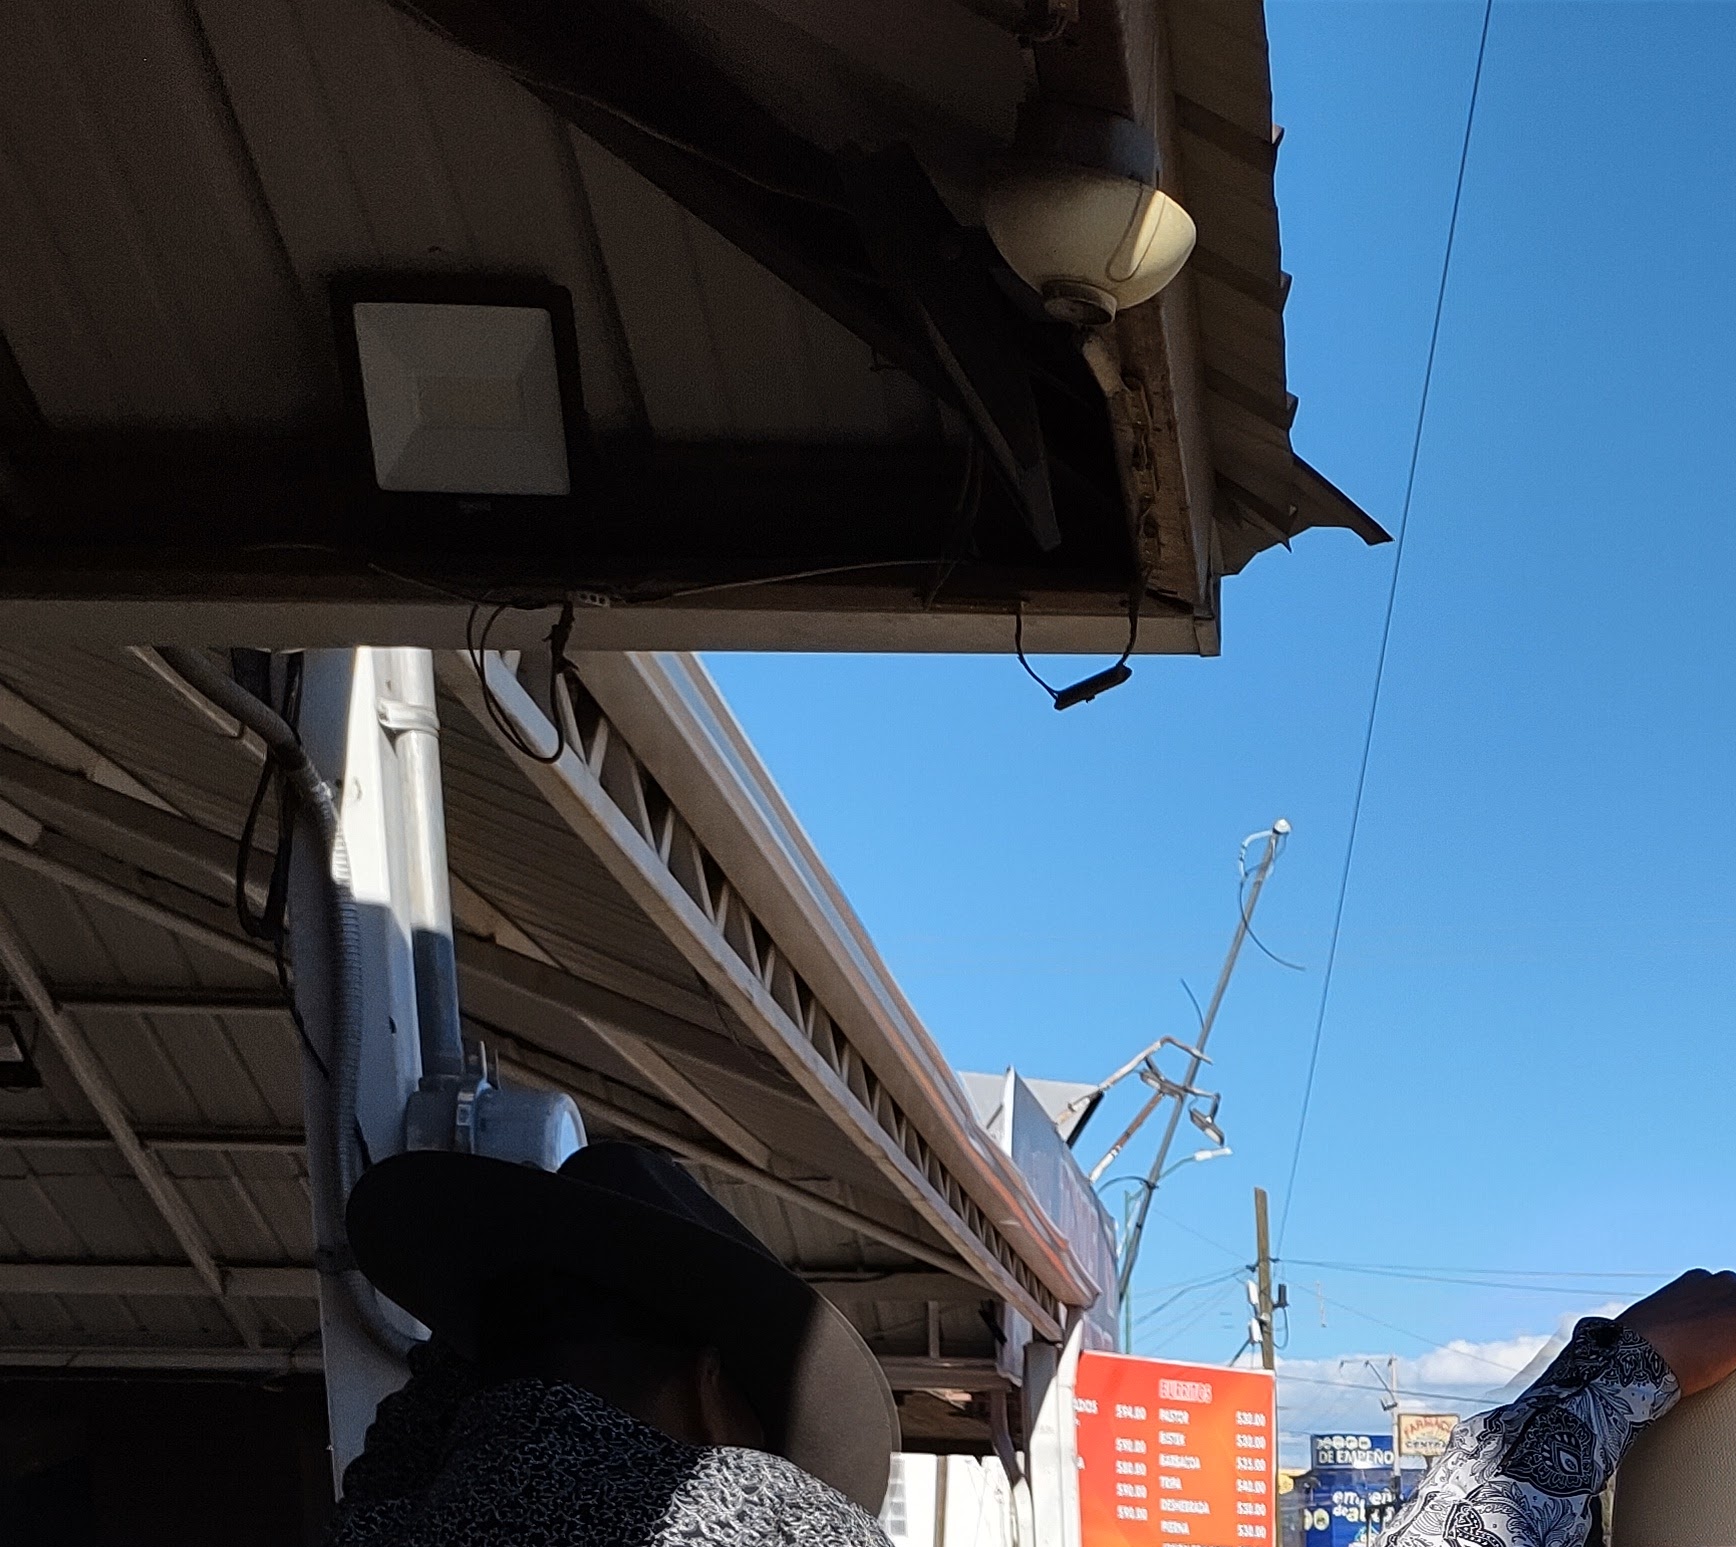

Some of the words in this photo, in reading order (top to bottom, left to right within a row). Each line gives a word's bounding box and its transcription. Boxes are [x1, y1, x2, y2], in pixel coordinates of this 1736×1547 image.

[1160, 1379, 1212, 1403] BURRITOS
[1319, 1450, 1334, 1464] DE
[1336, 1448, 1395, 1465] EMPEÑO
[1160, 1520, 1190, 1535] PIERNA
